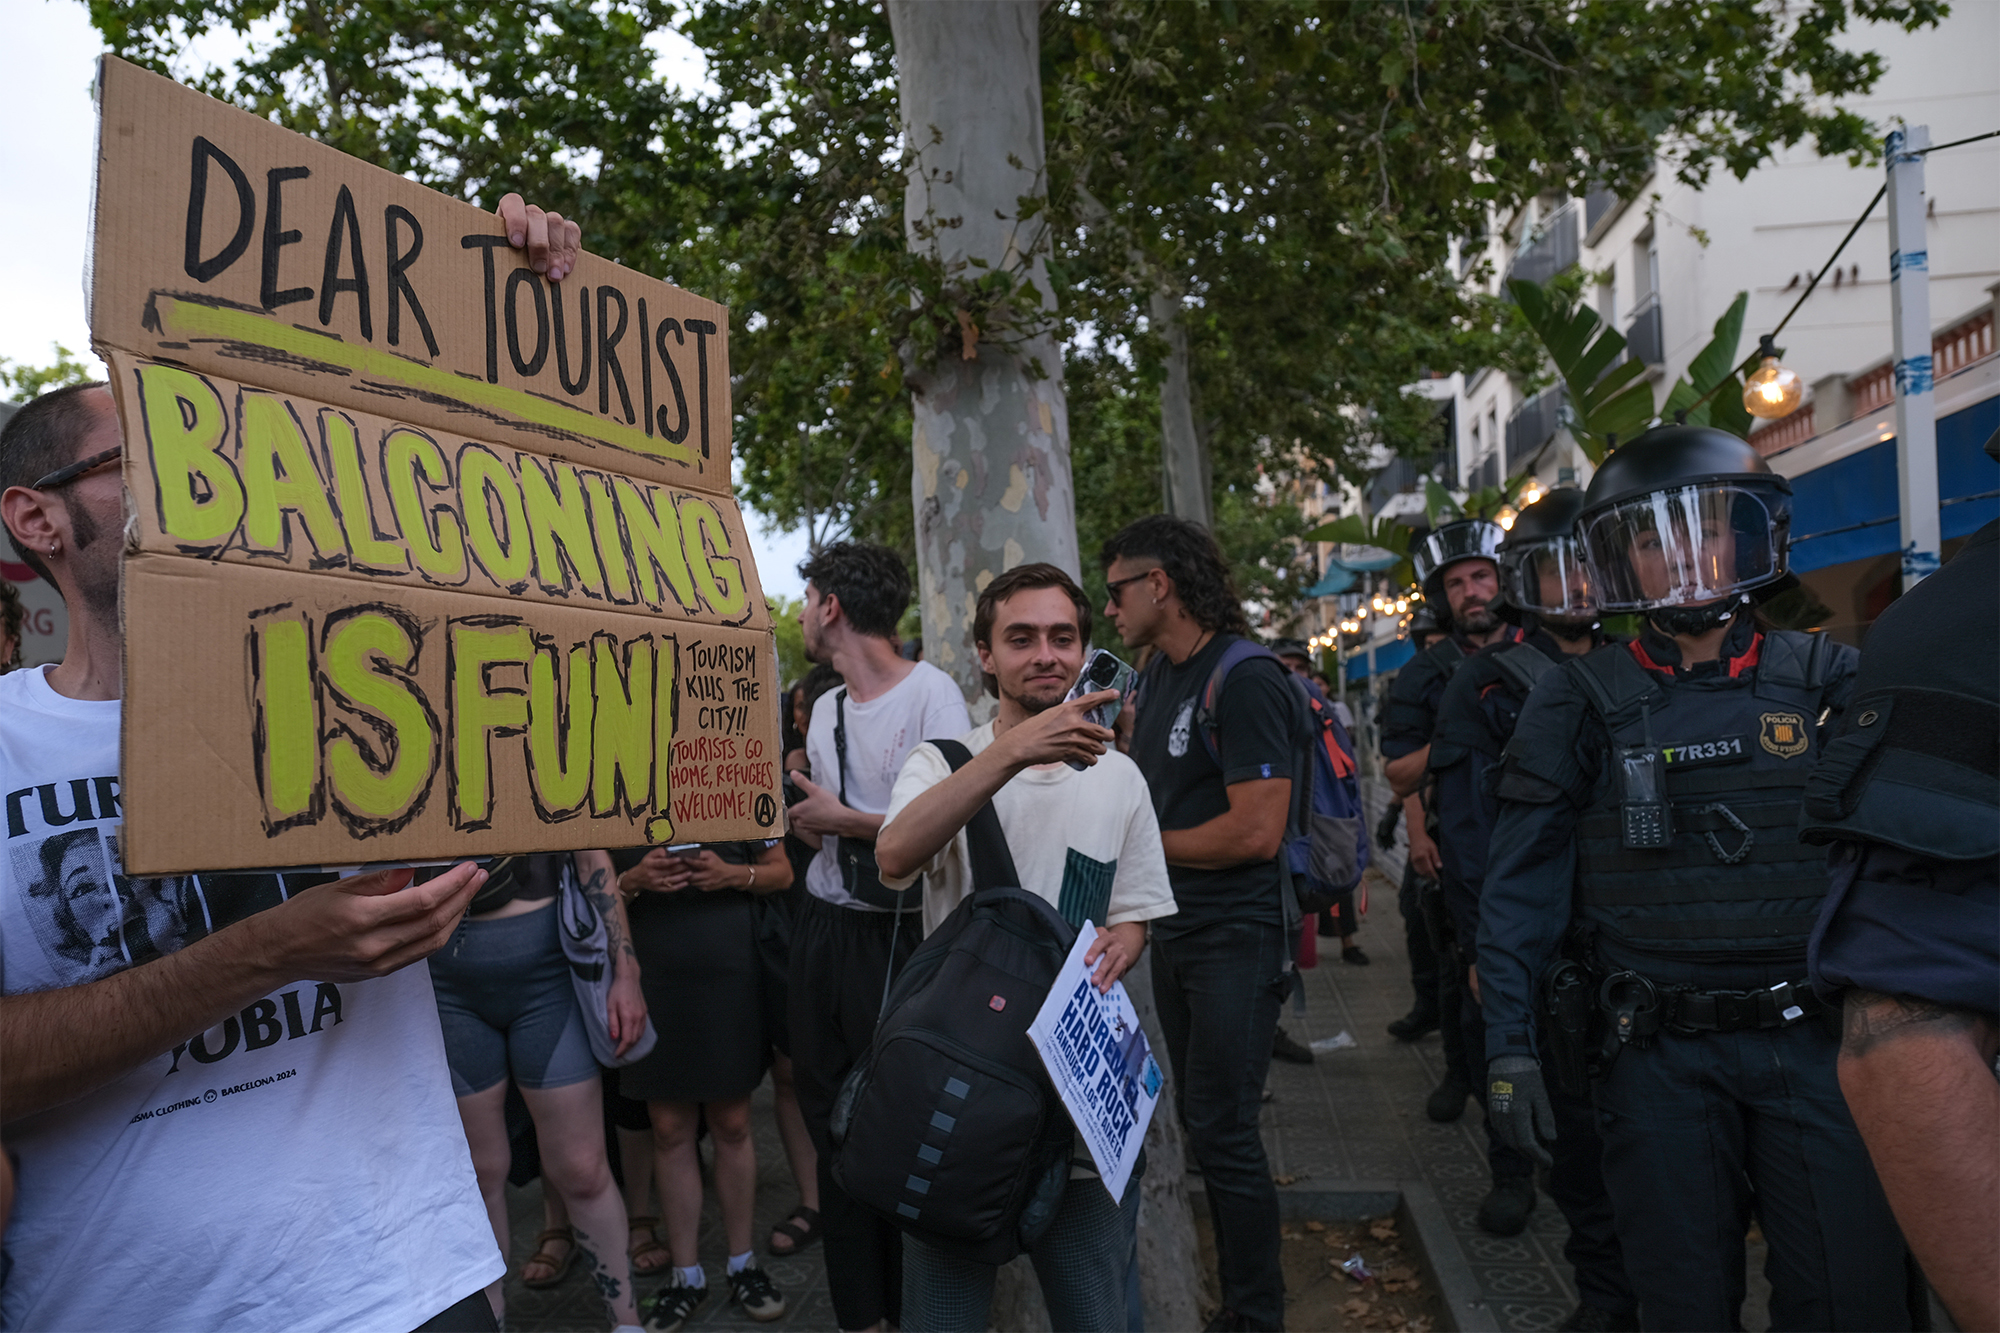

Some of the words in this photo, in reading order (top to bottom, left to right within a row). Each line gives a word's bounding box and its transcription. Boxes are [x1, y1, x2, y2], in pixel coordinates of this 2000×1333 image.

[185, 136, 439, 358] DEAR
[461, 234, 716, 458] TOURIST
[135, 363, 752, 625] BALCONING
[686, 640, 756, 678] TOURISM
[685, 675, 724, 702] KILLS
[732, 678, 760, 701] THE
[249, 601, 441, 839] IS
[447, 613, 680, 843] FUN!
[698, 705, 749, 736] CITY!!
[674, 736, 737, 764] TOURISTS
[745, 738, 763, 760] GO
[1662, 738, 1742, 764] T7R331
[670, 764, 713, 789] HOME,
[716, 761, 773, 790] REFUGEES
[674, 789, 753, 823] WELCOME!
[1073, 978, 1126, 1086] ATUREM
[156, 1096, 201, 1117] CLOTHING
[221, 1076, 275, 1097] BARCELONA
[276, 1068, 297, 1081] 2024
[1053, 1020, 1098, 1112] TANQUEM-LOS
[1096, 1105, 1122, 1161] L'AIXETA
[1060, 999, 1099, 1078] HARD
[1096, 1068, 1132, 1146] ROCK
